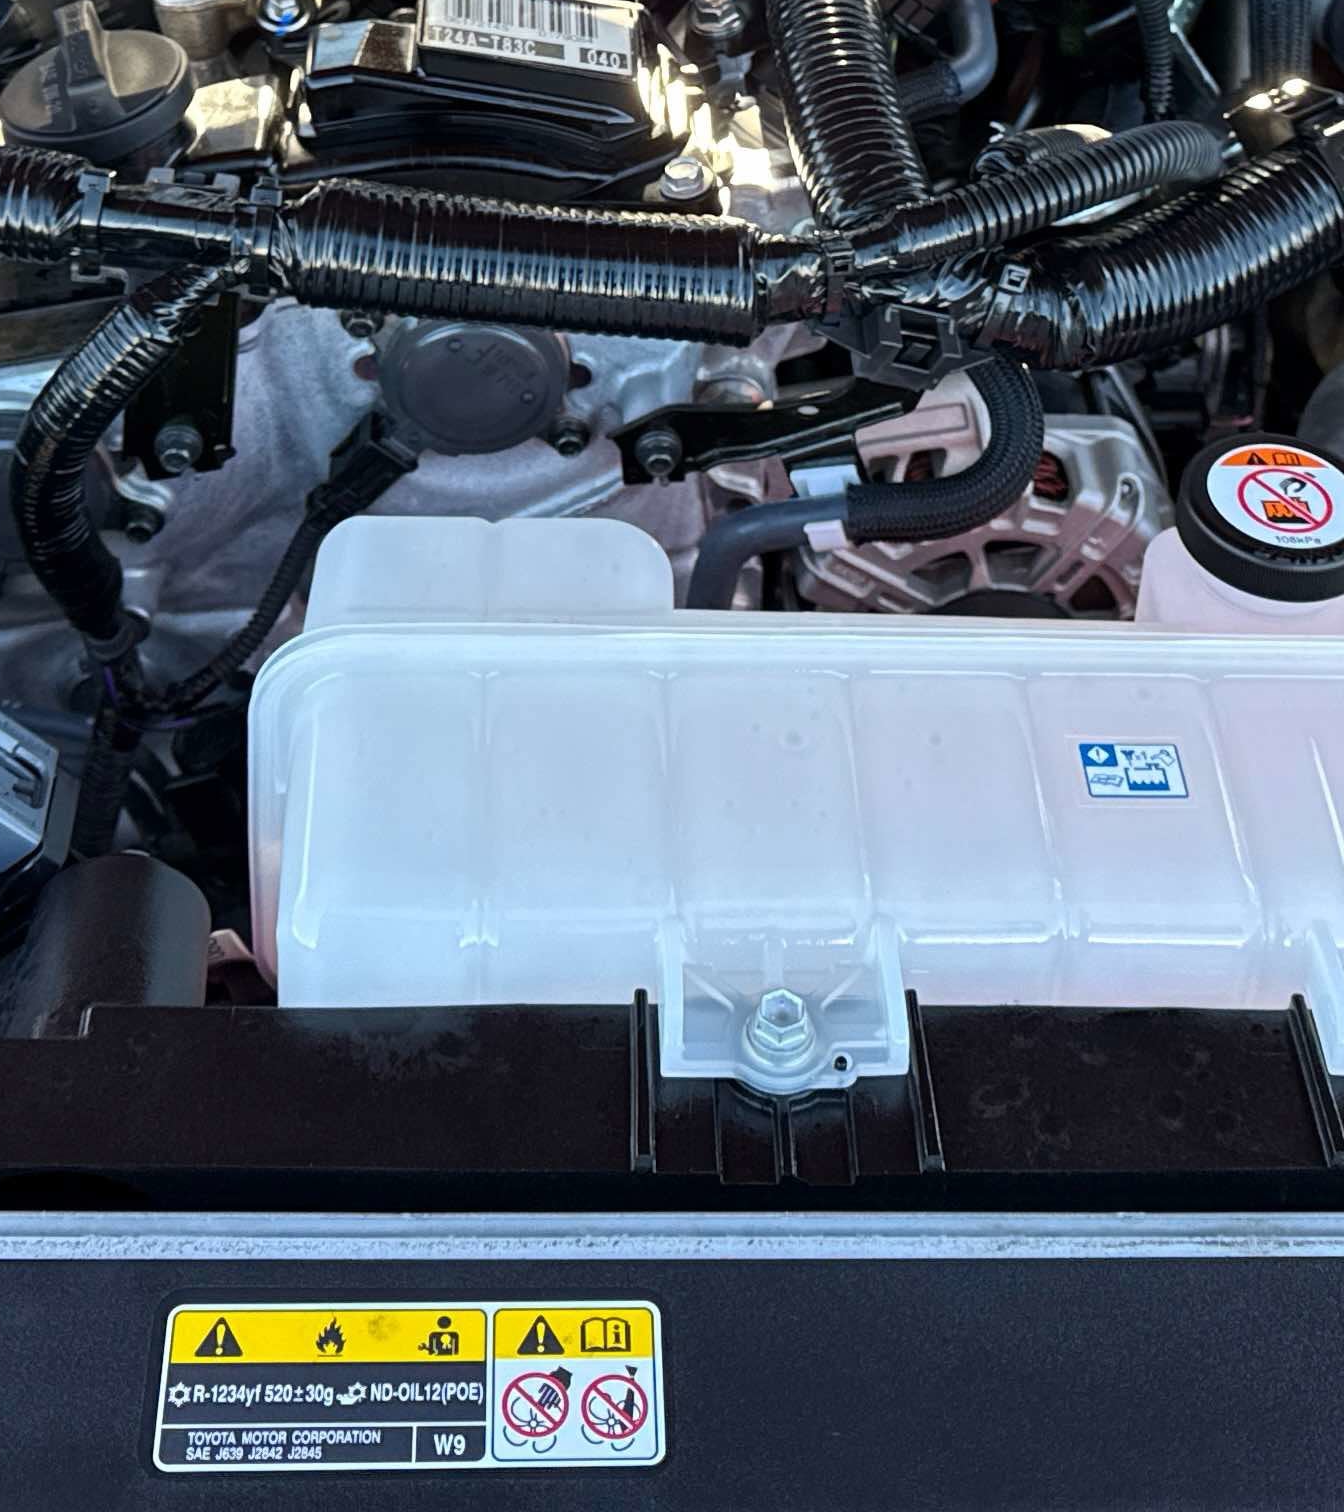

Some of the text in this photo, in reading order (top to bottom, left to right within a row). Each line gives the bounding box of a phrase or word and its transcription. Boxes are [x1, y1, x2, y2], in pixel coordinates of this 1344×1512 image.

[431, 26, 537, 56] T24A-T83C
[586, 49, 622, 68] 040
[1275, 535, 1322, 545] 108kPa
[192, 1382, 484, 1408] R-1234yf 520±30g ND-OIL12(POE)
[187, 1429, 382, 1445] TOYOTA MOTOR CORPORATION
[433, 1433, 467, 1456] W9
[185, 1445, 323, 1461] SAE J639 J2842 J2845
